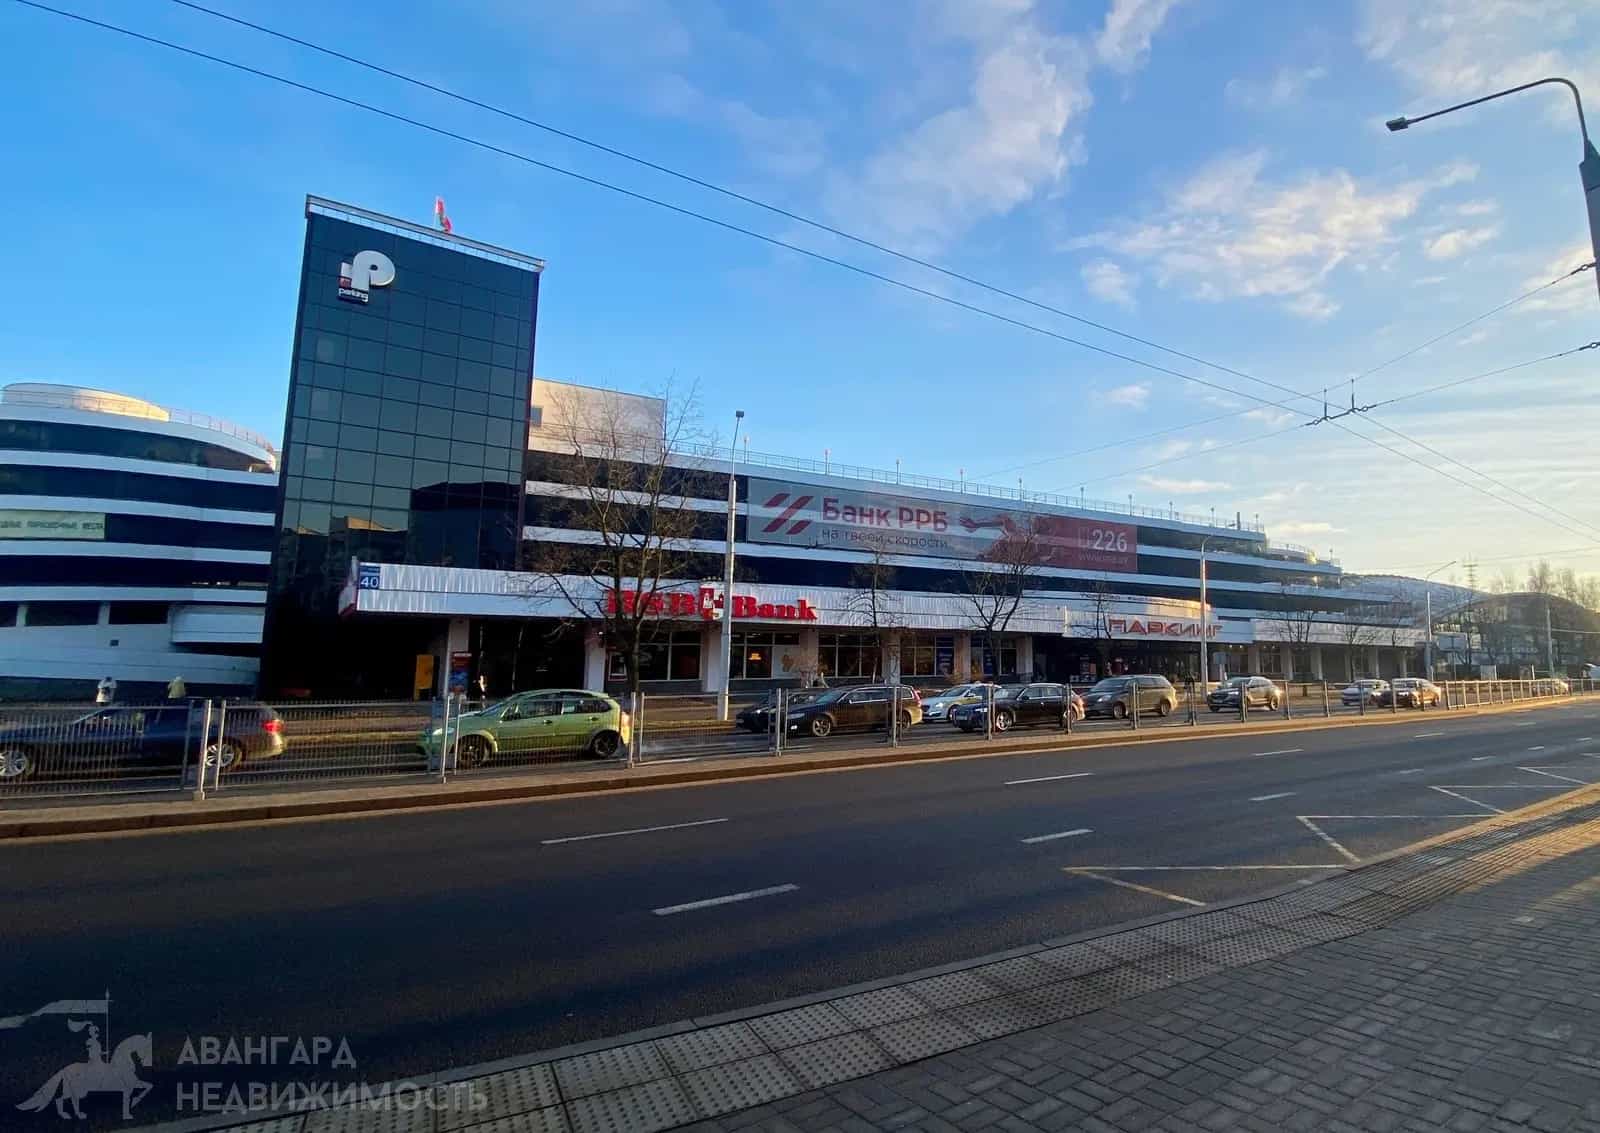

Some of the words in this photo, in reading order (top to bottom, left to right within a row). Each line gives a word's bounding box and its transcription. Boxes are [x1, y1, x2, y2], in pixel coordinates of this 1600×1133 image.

[822, 496, 891, 528] Банк
[898, 506, 948, 533] РРБ
[822, 529, 839, 540] на
[887, 535, 948, 549] скорости
[360, 576, 379, 589] 40
[731, 595, 818, 620] Bank
[1108, 618, 1223, 638] ПАРКИНГ
